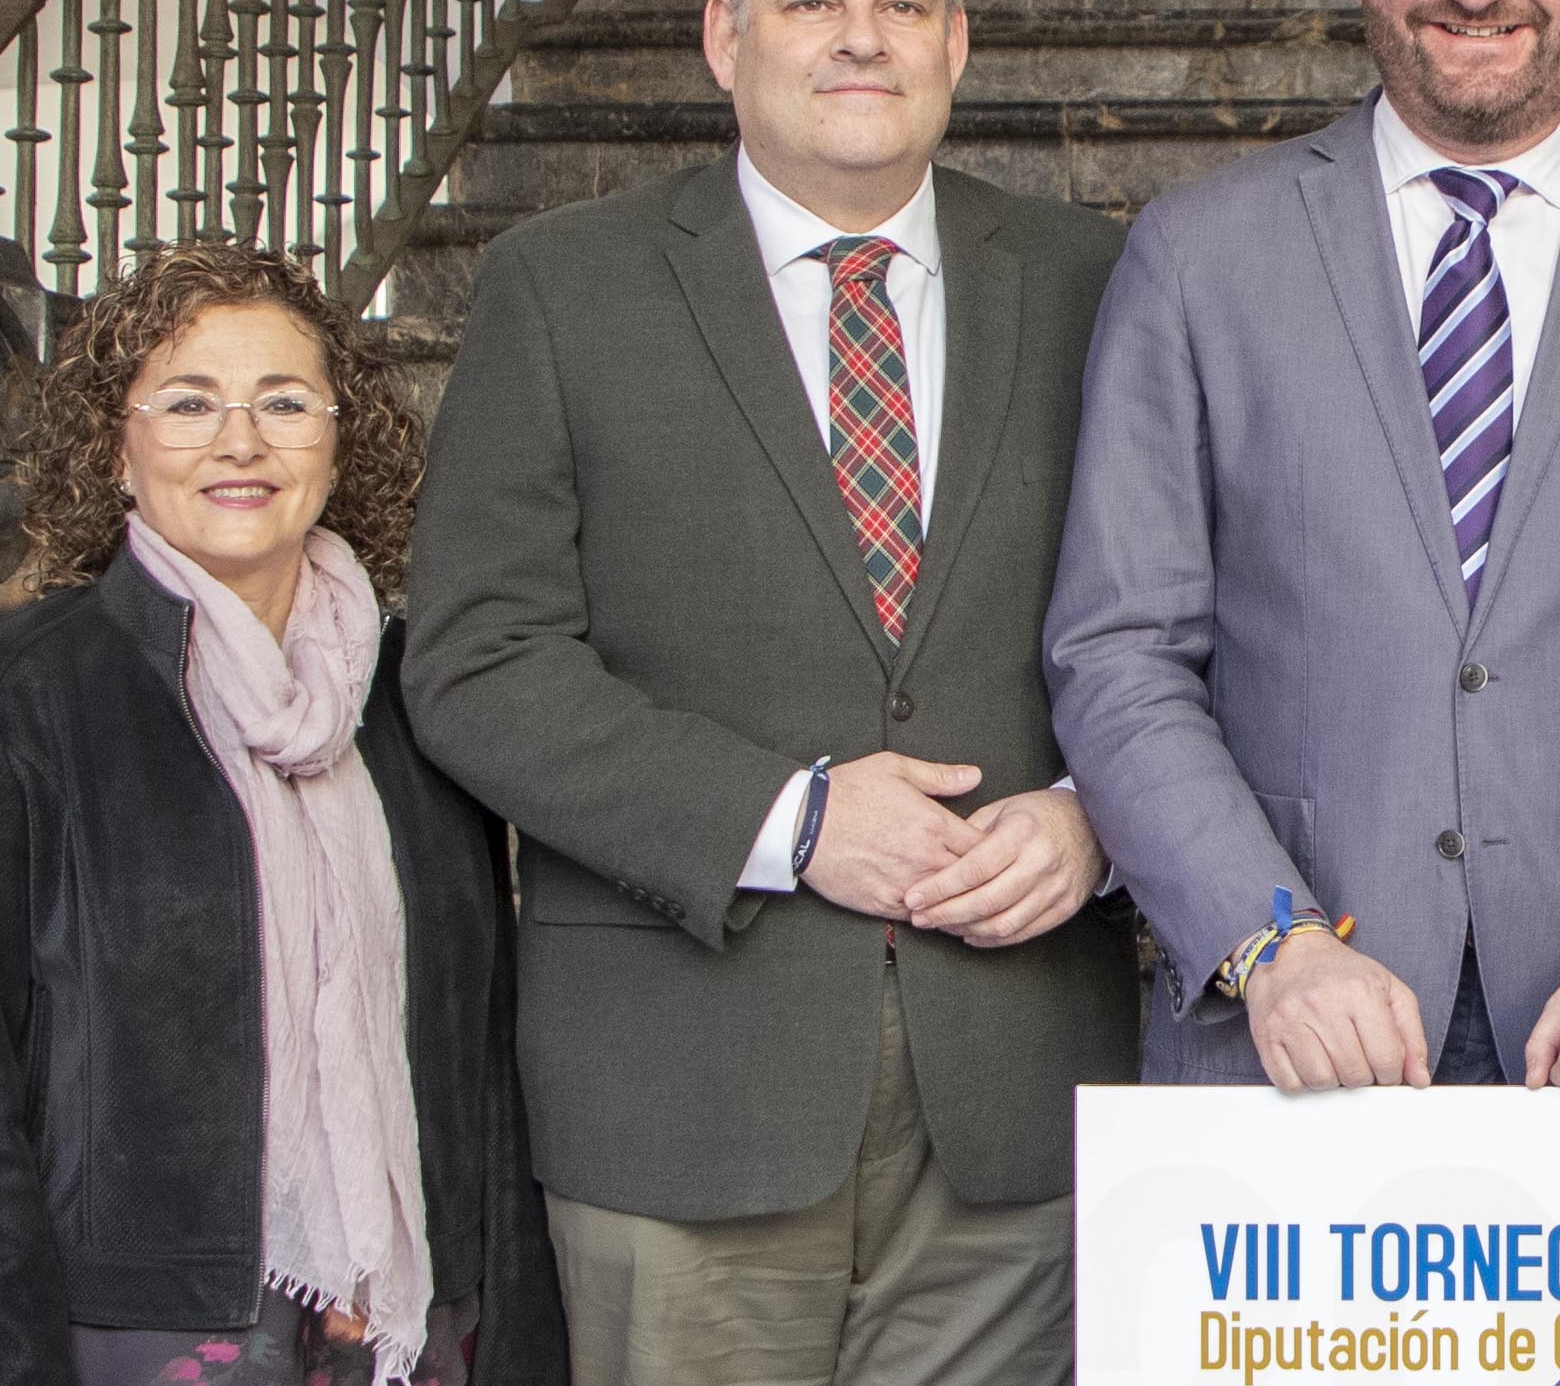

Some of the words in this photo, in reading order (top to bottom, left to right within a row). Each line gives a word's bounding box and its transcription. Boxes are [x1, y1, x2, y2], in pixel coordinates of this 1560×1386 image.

[1201, 1223, 1300, 1301] VIII
[1200, 1310, 1459, 1385] Diputación
[1478, 1313, 1536, 1372] de
